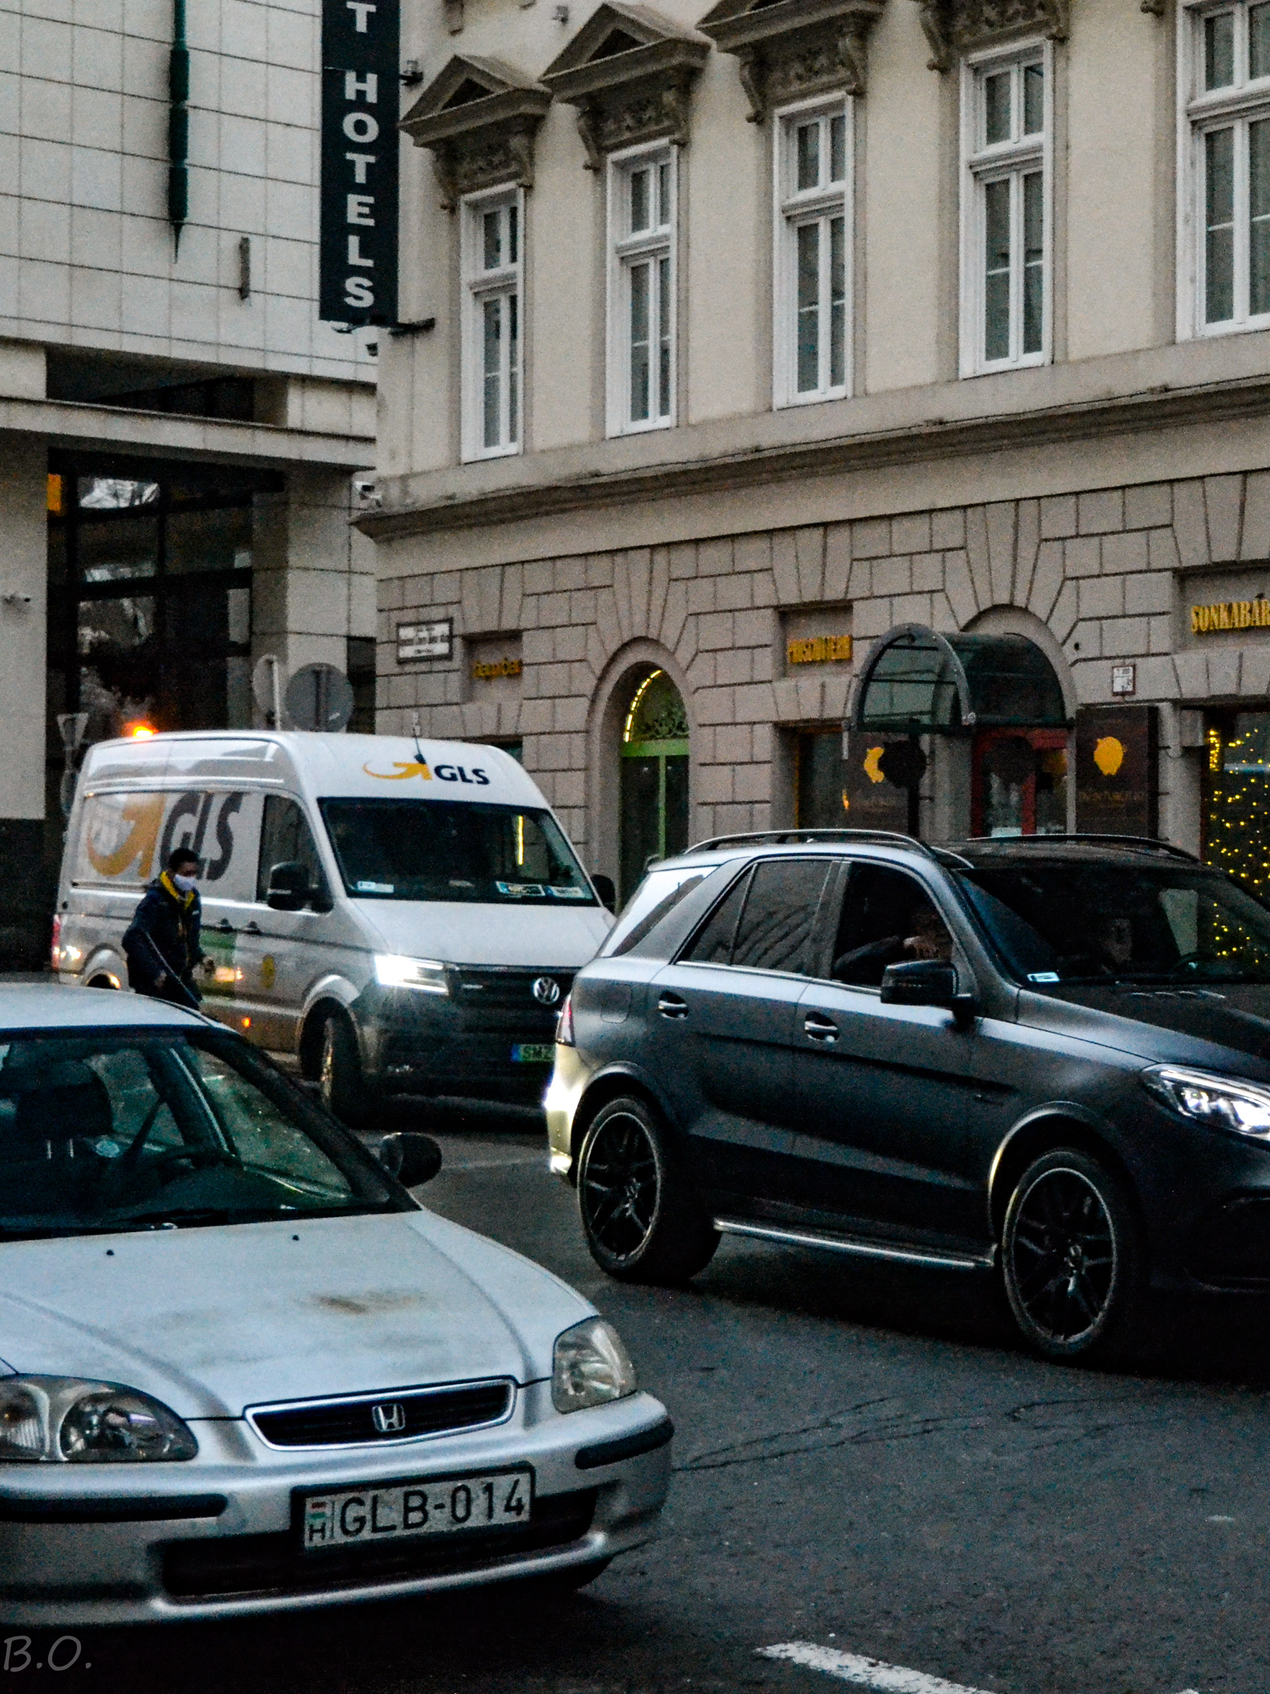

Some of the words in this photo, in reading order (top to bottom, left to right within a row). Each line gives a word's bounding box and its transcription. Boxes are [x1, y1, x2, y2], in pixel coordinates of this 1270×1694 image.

[342, 71, 378, 309] HOTELS
[434, 764, 490, 786] GLS
[160, 791, 244, 881] GLS
[340, 1478, 525, 1538] GLB-014
